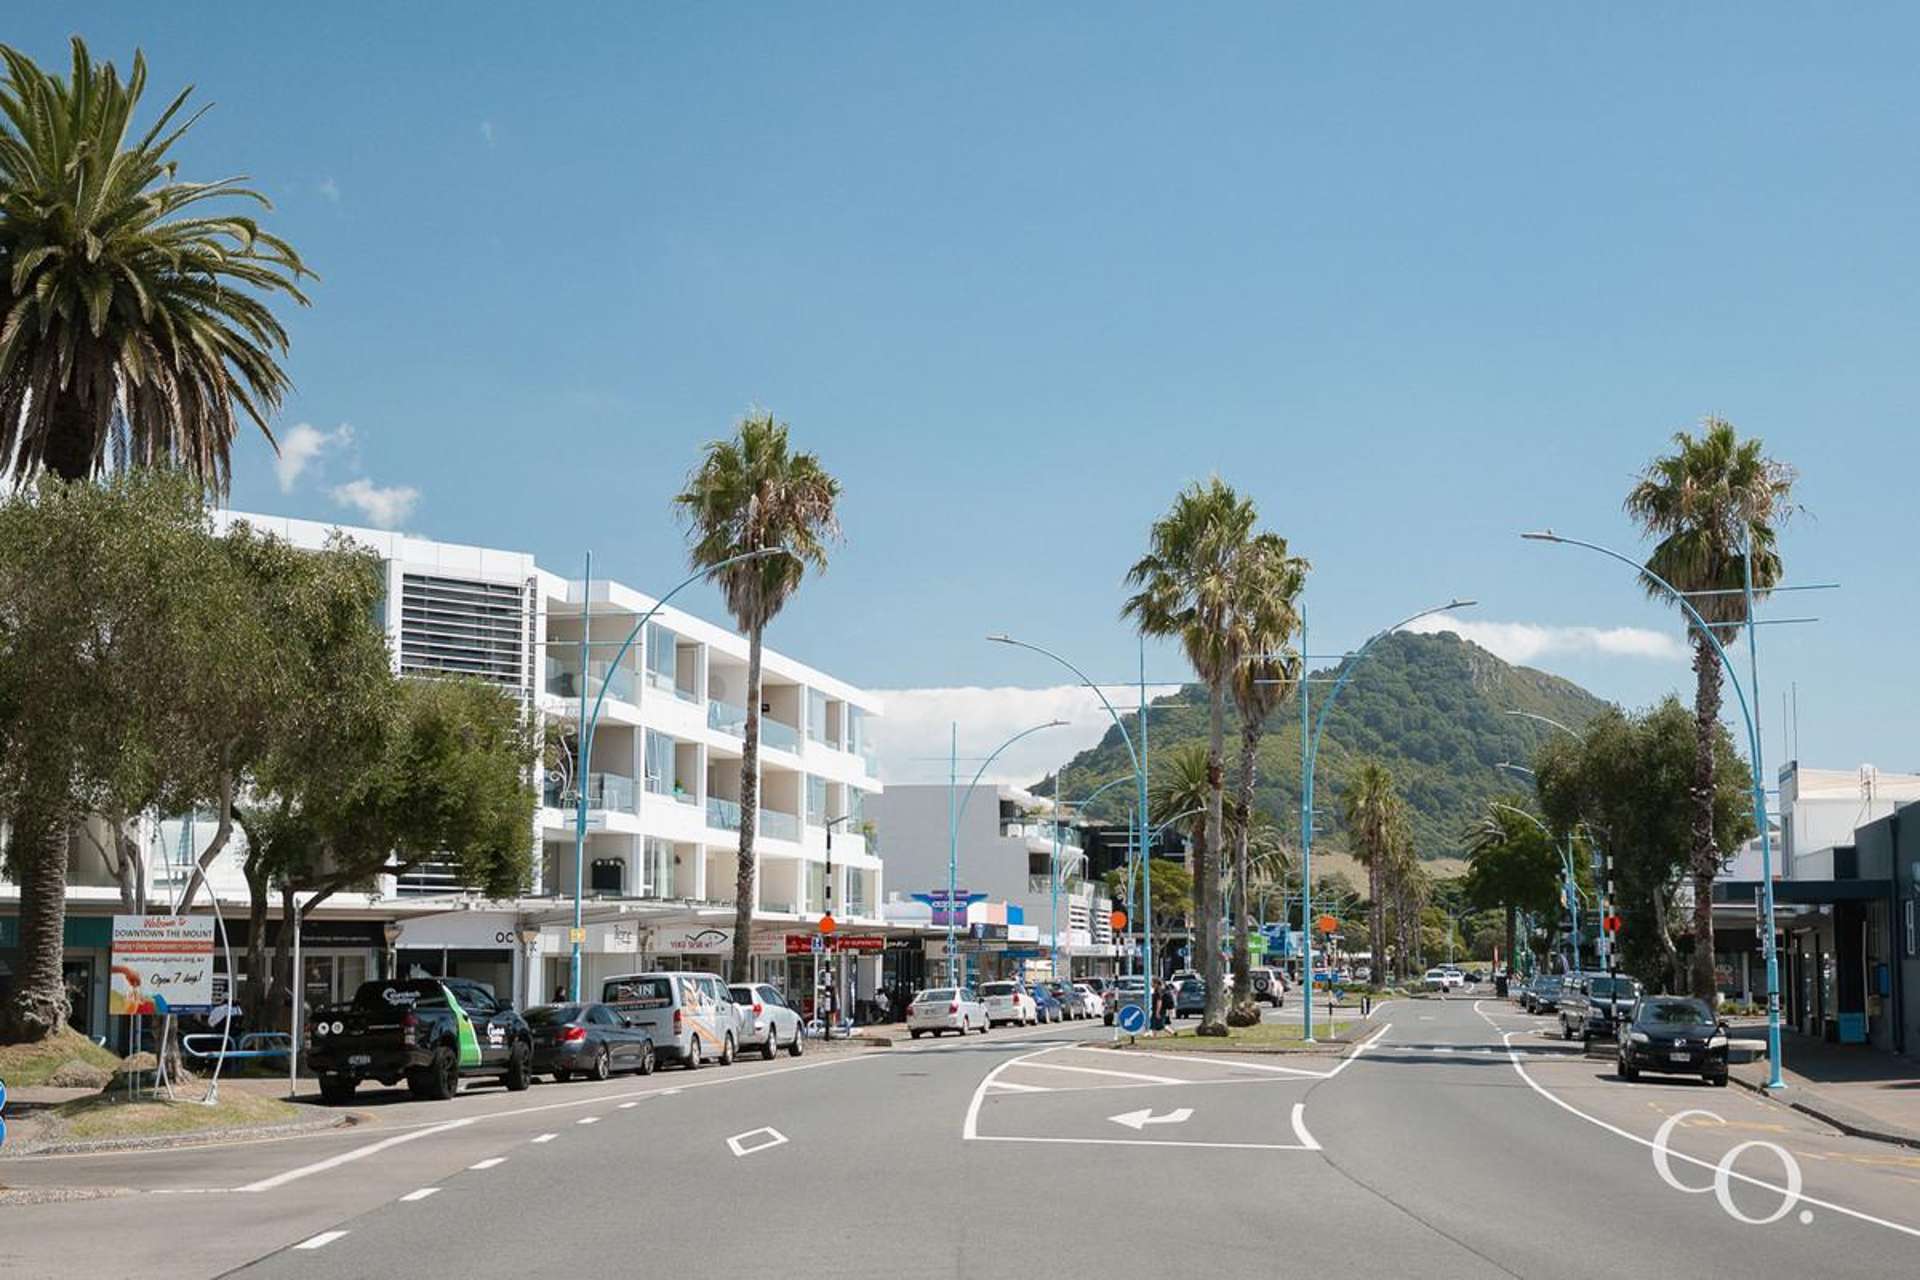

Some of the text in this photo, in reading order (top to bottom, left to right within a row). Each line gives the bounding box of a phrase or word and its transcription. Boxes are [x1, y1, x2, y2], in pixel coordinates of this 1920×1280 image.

[114, 929, 212, 938] DOWNTOWN THE MOUNT
[150, 973, 170, 988] Open
[174, 972, 182, 984] 7
